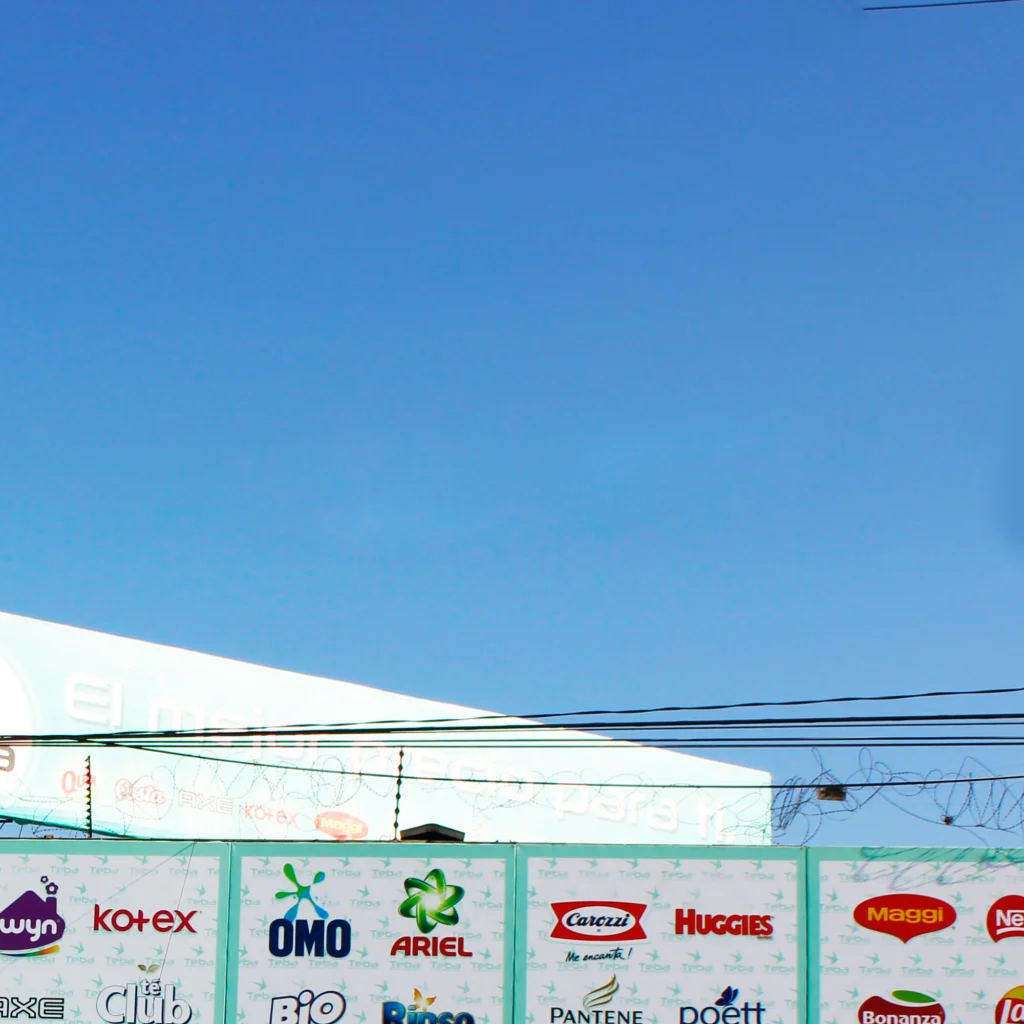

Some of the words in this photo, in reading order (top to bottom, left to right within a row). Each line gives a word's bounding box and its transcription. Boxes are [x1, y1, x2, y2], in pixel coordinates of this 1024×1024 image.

[177, 789, 234, 815] AXE
[93, 903, 198, 933] kotex
[566, 912, 630, 927] Carozzi
[675, 908, 774, 936] HUGGIES
[867, 906, 944, 924] Maggi
[0, 917, 57, 942] wyn
[268, 918, 352, 958] OMO
[390, 936, 473, 957] ARIEL
[565, 950, 580, 962] Me
[550, 1007, 643, 1024] PANTENE
